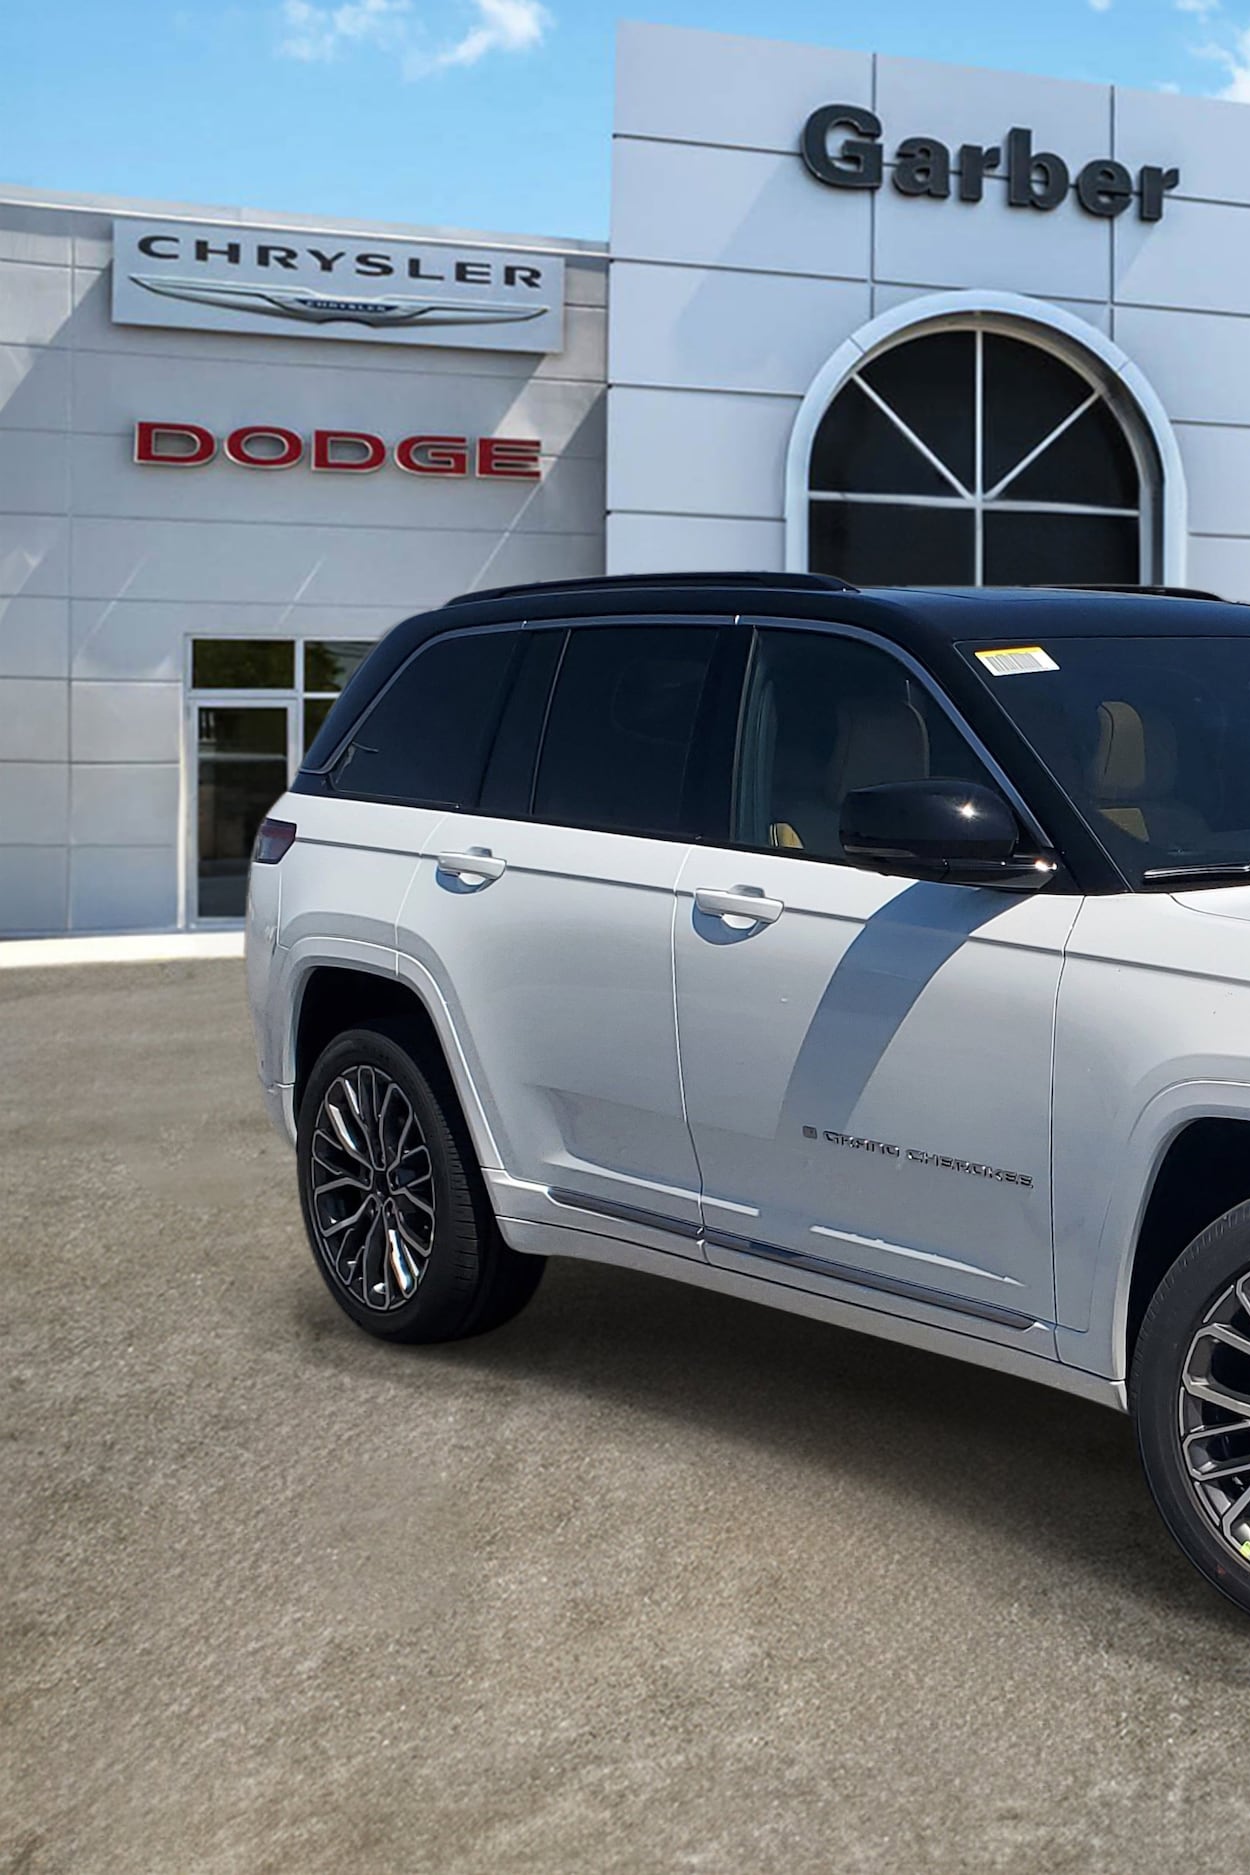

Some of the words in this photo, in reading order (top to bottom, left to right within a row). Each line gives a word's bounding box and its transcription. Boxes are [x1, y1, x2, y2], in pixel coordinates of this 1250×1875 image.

[801, 104, 1180, 221] Garber
[138, 236, 542, 287] CHRYSLER
[134, 421, 542, 480] DODGE
[822, 1130, 900, 1158] GRAND
[905, 1149, 1034, 1188] CHEROKEE
